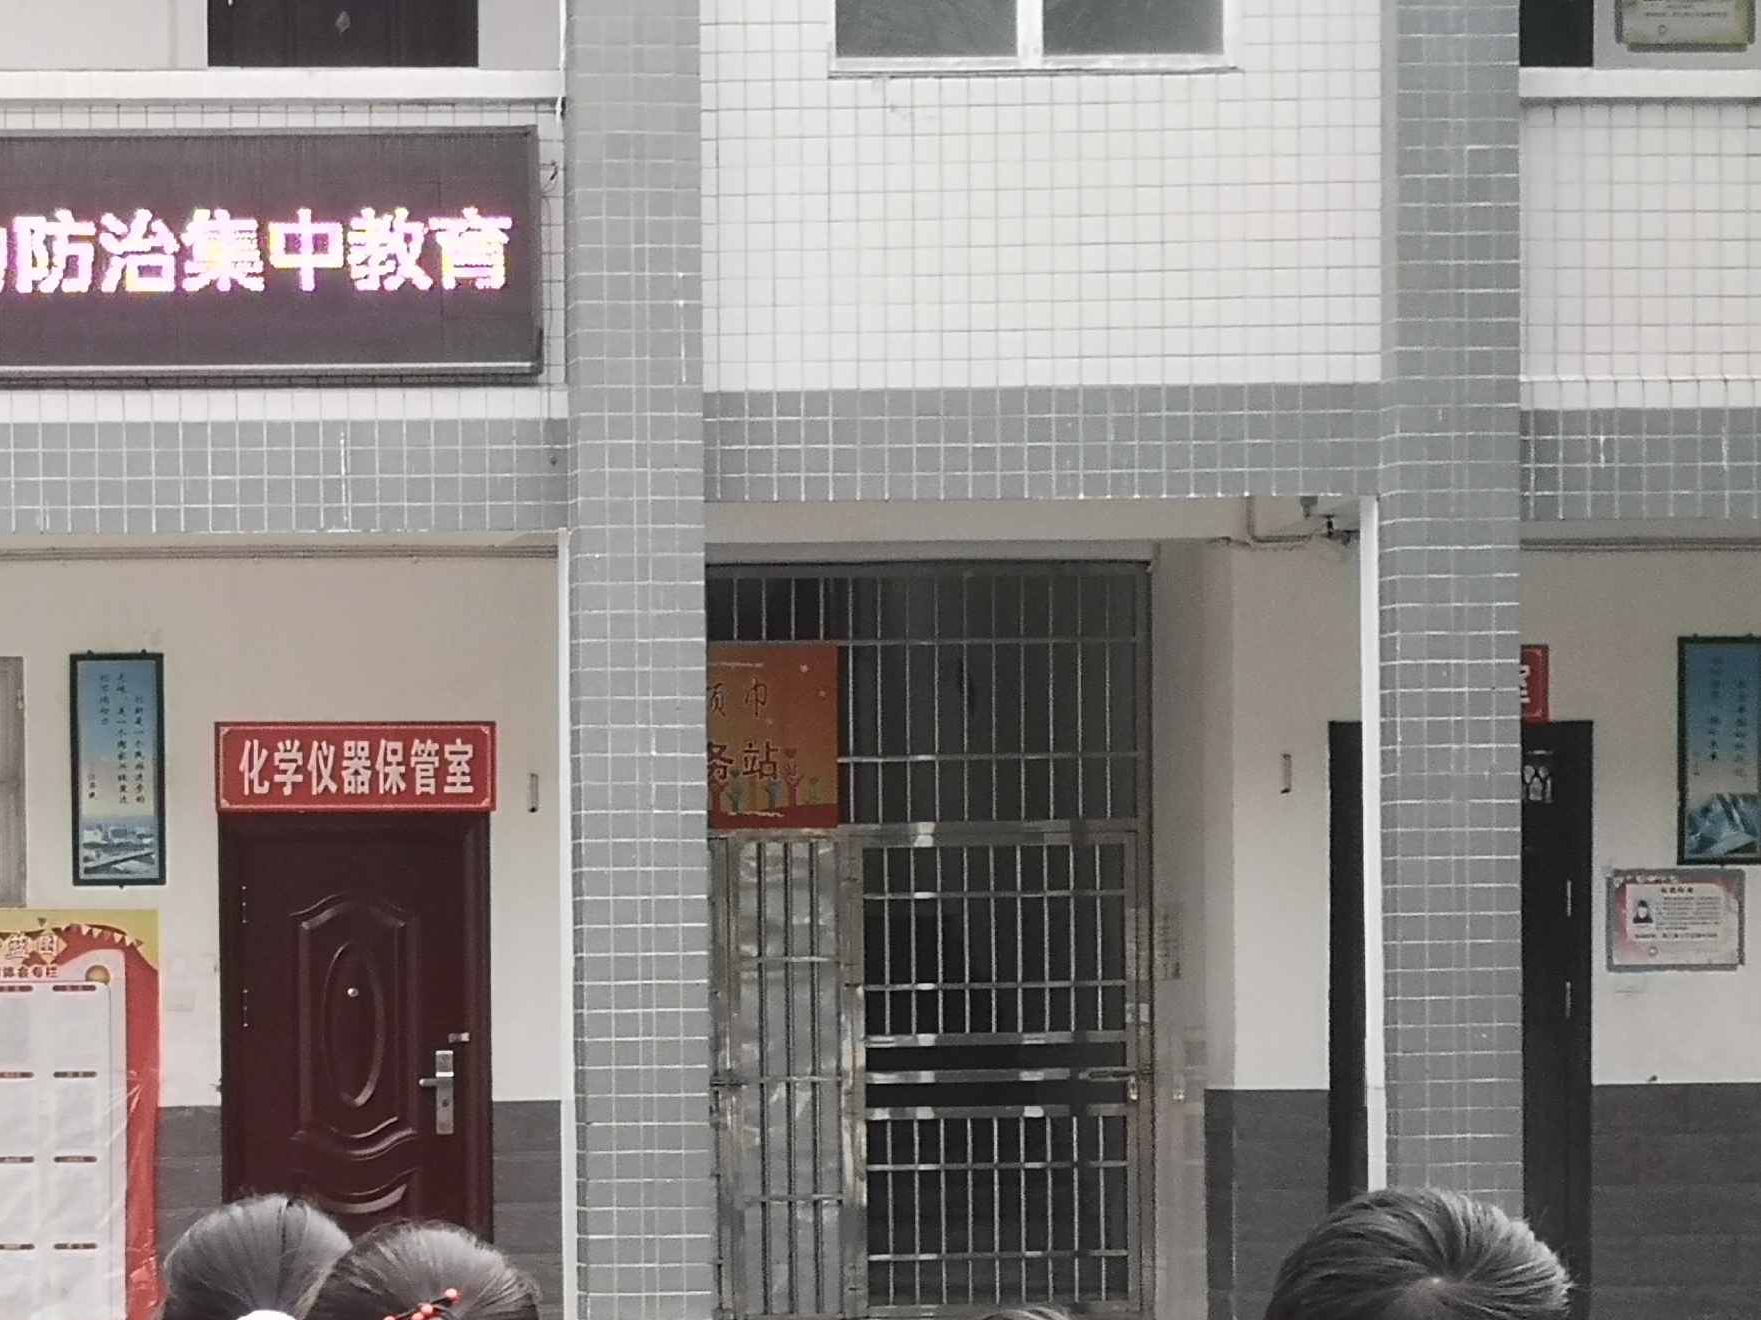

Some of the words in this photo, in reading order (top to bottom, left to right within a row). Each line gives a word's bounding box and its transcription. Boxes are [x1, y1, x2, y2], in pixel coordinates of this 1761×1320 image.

[239, 737, 475, 796] 化学仪器保管室
